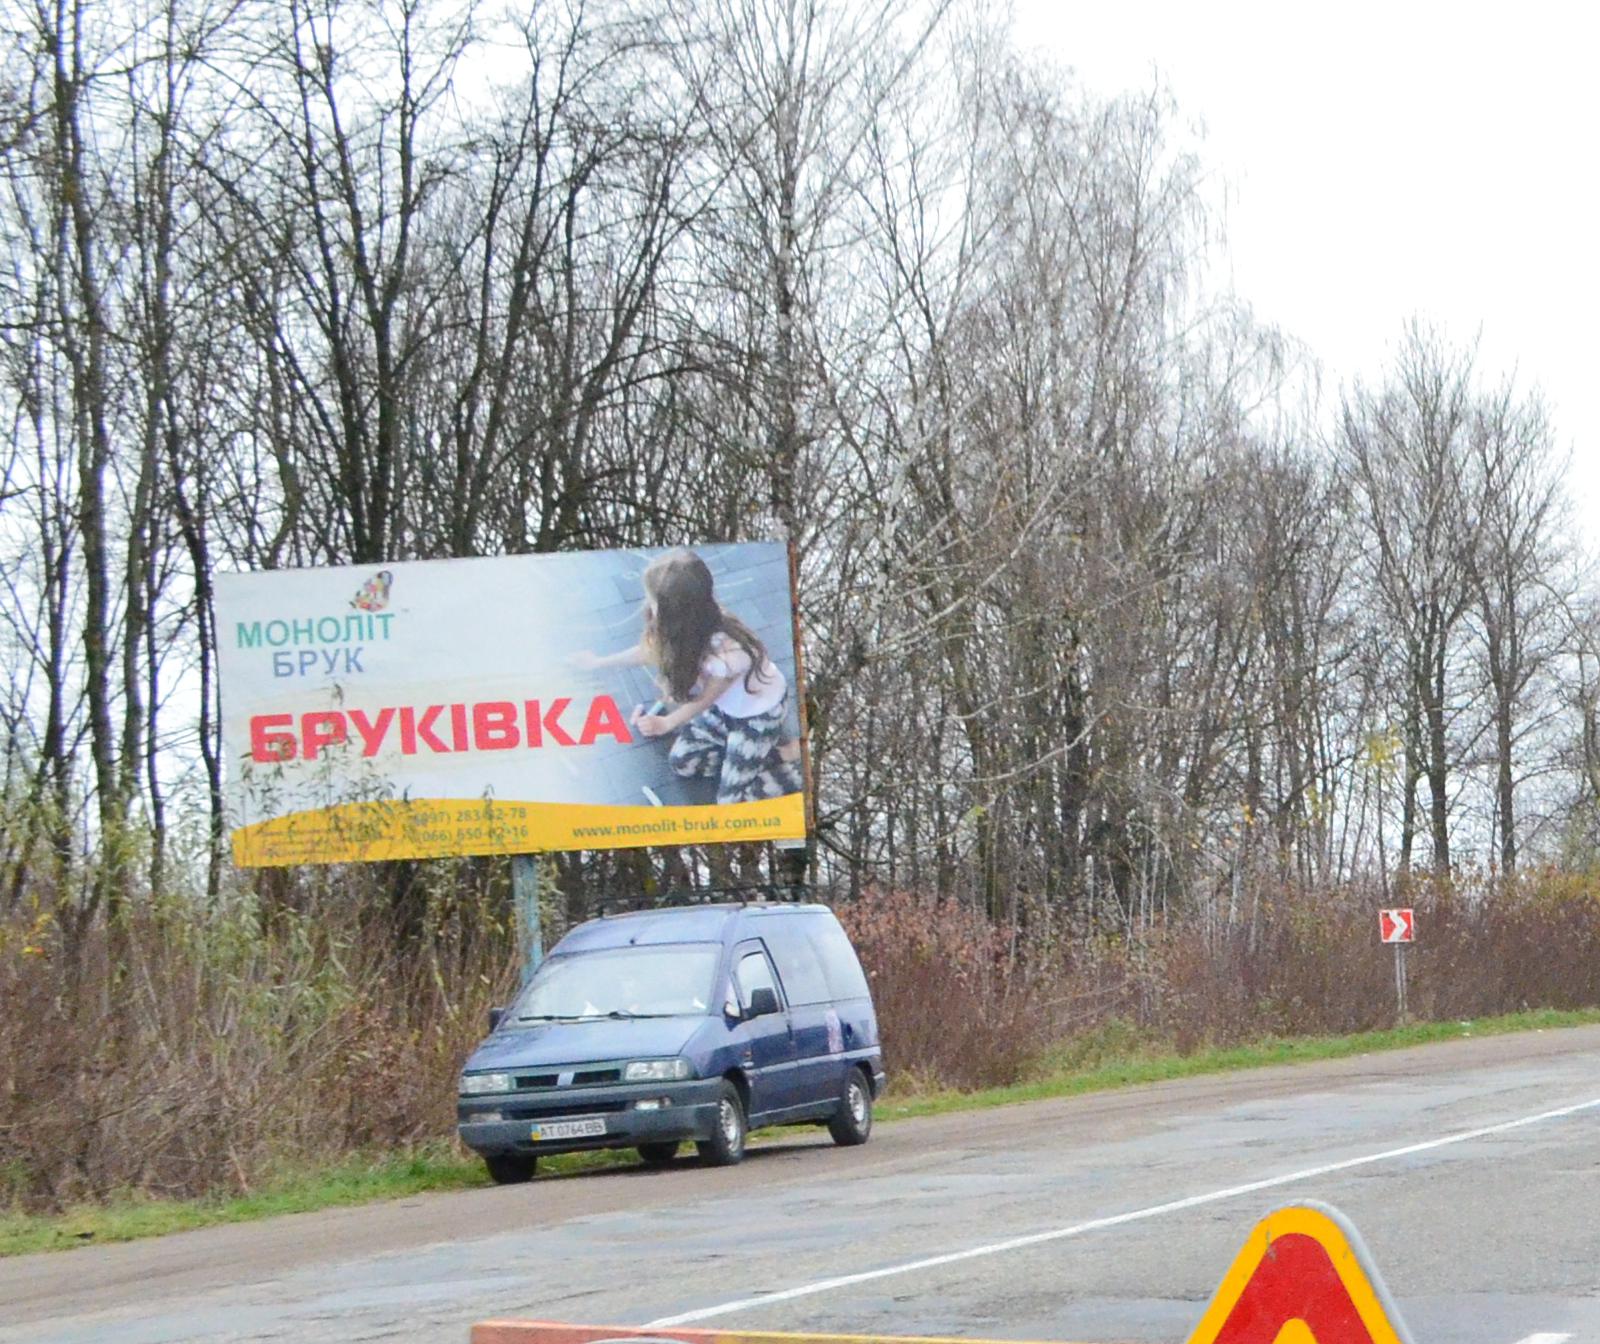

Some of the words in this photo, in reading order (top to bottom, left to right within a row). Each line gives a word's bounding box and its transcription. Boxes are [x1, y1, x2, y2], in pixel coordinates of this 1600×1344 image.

[236, 613, 395, 648] МОНОЛІТ
[272, 647, 364, 678] БРУК
[249, 694, 634, 764] БРУКІВКА
[572, 815, 782, 838] www.monolit-bruk.com.ua
